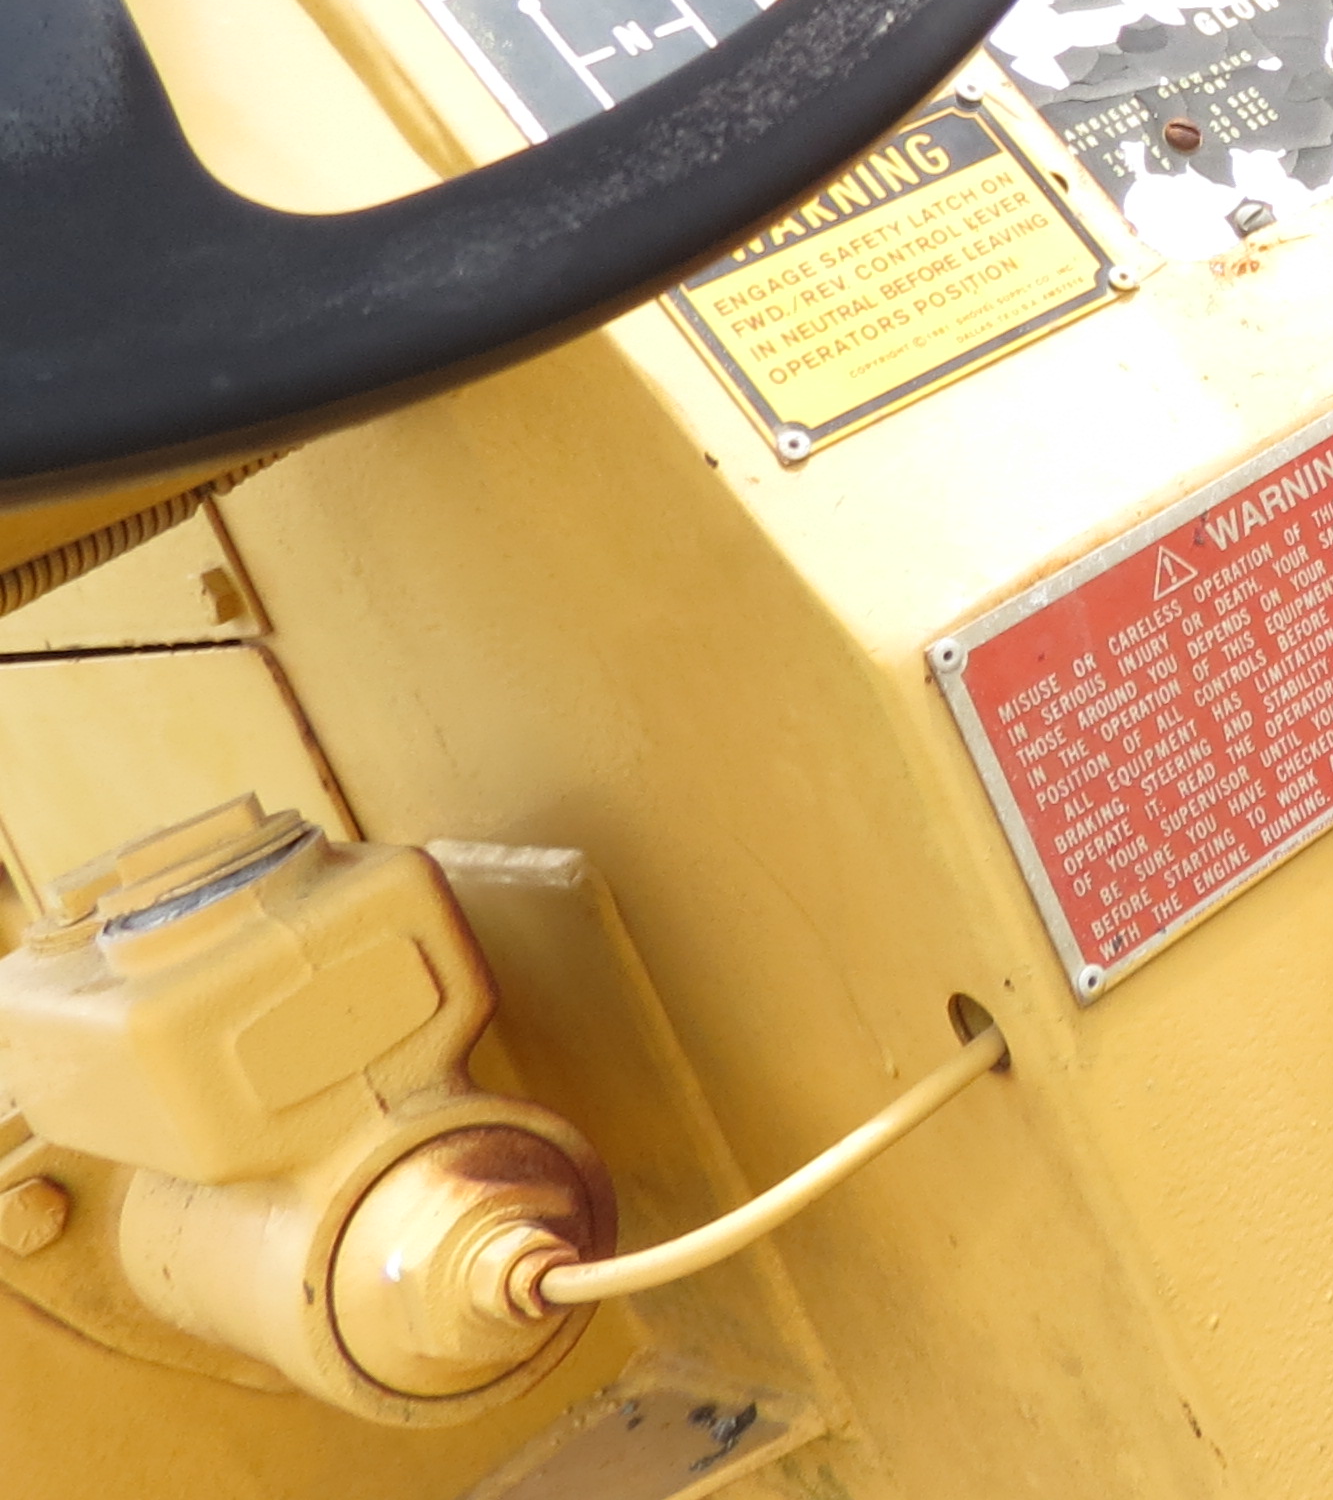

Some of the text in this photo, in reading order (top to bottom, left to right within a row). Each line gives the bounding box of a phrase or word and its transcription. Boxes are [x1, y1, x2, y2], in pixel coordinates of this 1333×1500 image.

[612, 20, 653, 57] N
[1158, 50, 1251, 99] GLOW PLUG
[1227, 86, 1260, 109] SEC
[1209, 97, 1269, 133] 20 SEC
[1219, 109, 1279, 144] 30 SEC
[712, 170, 1014, 317] ENGAGE SAFETY LATCH ON
[748, 339, 778, 362] IN
[779, 292, 879, 347] NEUTRAL
[878, 253, 961, 300] BEFORE
[961, 212, 1050, 261] LEAVING
[852, 222, 962, 282] CONTROL
[961, 190, 1031, 230] LEVER
[765, 307, 912, 385] OPERATORS
[911, 256, 1020, 316] POSITION
[997, 672, 1061, 725] MISUSE
[1072, 652, 1097, 678] OR
[1108, 598, 1183, 656] CARELESS
[1193, 540, 1273, 603] OPERATION
[1283, 521, 1301, 546] OF
[1007, 721, 1028, 747] IN
[1041, 672, 1106, 725] SERIOUS
[1117, 631, 1169, 677] INJURY
[1181, 611, 1204, 636] OR
[1214, 576, 1263, 616] DEATH.
[1272, 543, 1309, 578] YOUR
[1015, 724, 1067, 768] THOSE
[1077, 680, 1137, 731] AROUND
[1146, 653, 1178, 684] YOU
[1186, 607, 1251, 660] DEPENDS
[1259, 586, 1282, 612] ON
[1289, 558, 1326, 592] YOUR
[1026, 764, 1047, 790] IN
[1057, 737, 1090, 768] THE
[1098, 676, 1182, 743] OPERATION
[1192, 657, 1210, 682] OF
[1220, 630, 1255, 662] THIS
[1035, 750, 1111, 812] POSITION
[1122, 728, 1142, 754] OF
[1156, 705, 1184, 734] ALL
[1193, 648, 1267, 707] CONTROLS
[1277, 606, 1330, 653] BEFORE
[1064, 791, 1094, 822] ALL
[1106, 718, 1197, 792] EQUIPMENT
[1211, 691, 1242, 723] HAS
